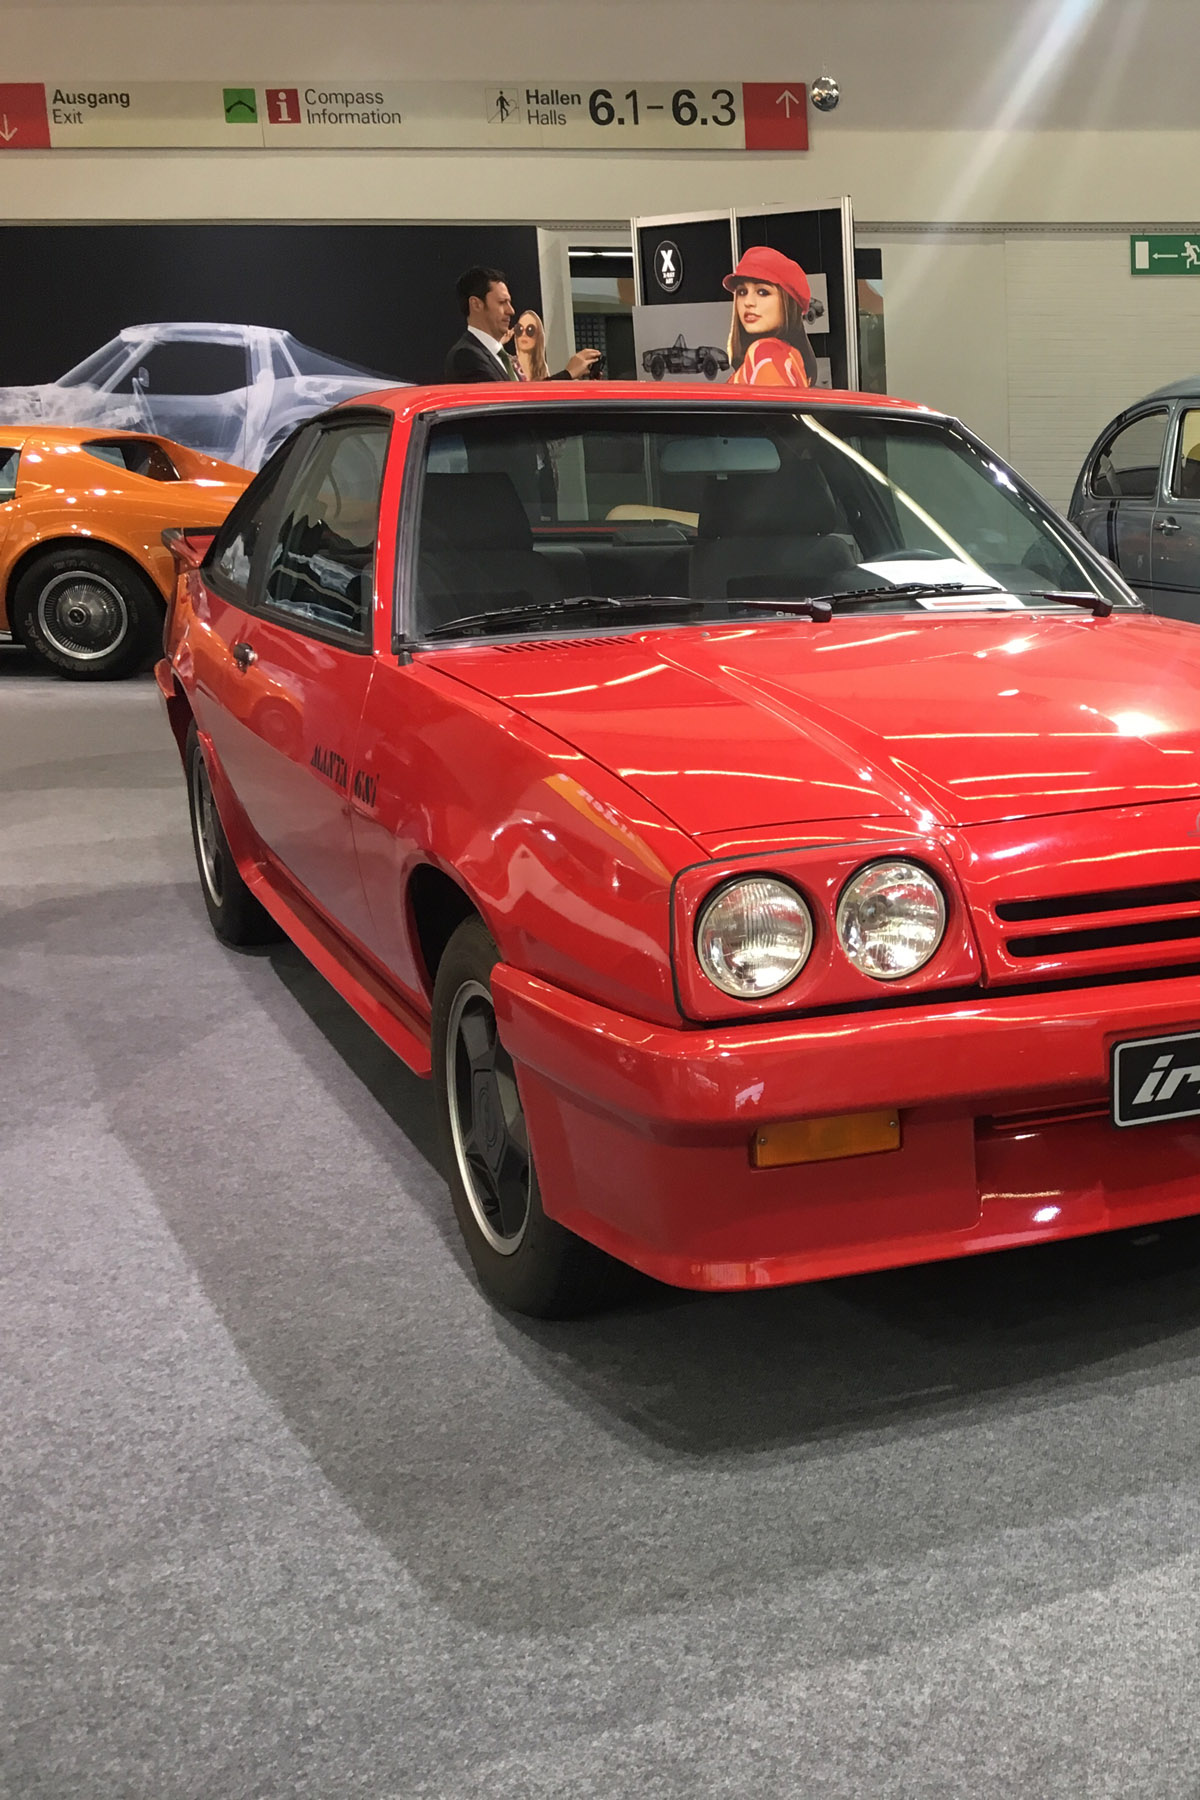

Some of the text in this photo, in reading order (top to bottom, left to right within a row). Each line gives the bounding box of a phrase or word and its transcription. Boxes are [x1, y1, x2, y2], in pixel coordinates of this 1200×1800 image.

[51, 88, 131, 108] Ausgang
[304, 88, 384, 107] Compass
[525, 89, 582, 106] Hallen
[52, 108, 84, 125] Exit
[306, 108, 402, 125] Information
[526, 108, 567, 126] Halls
[660, 249, 676, 272] X
